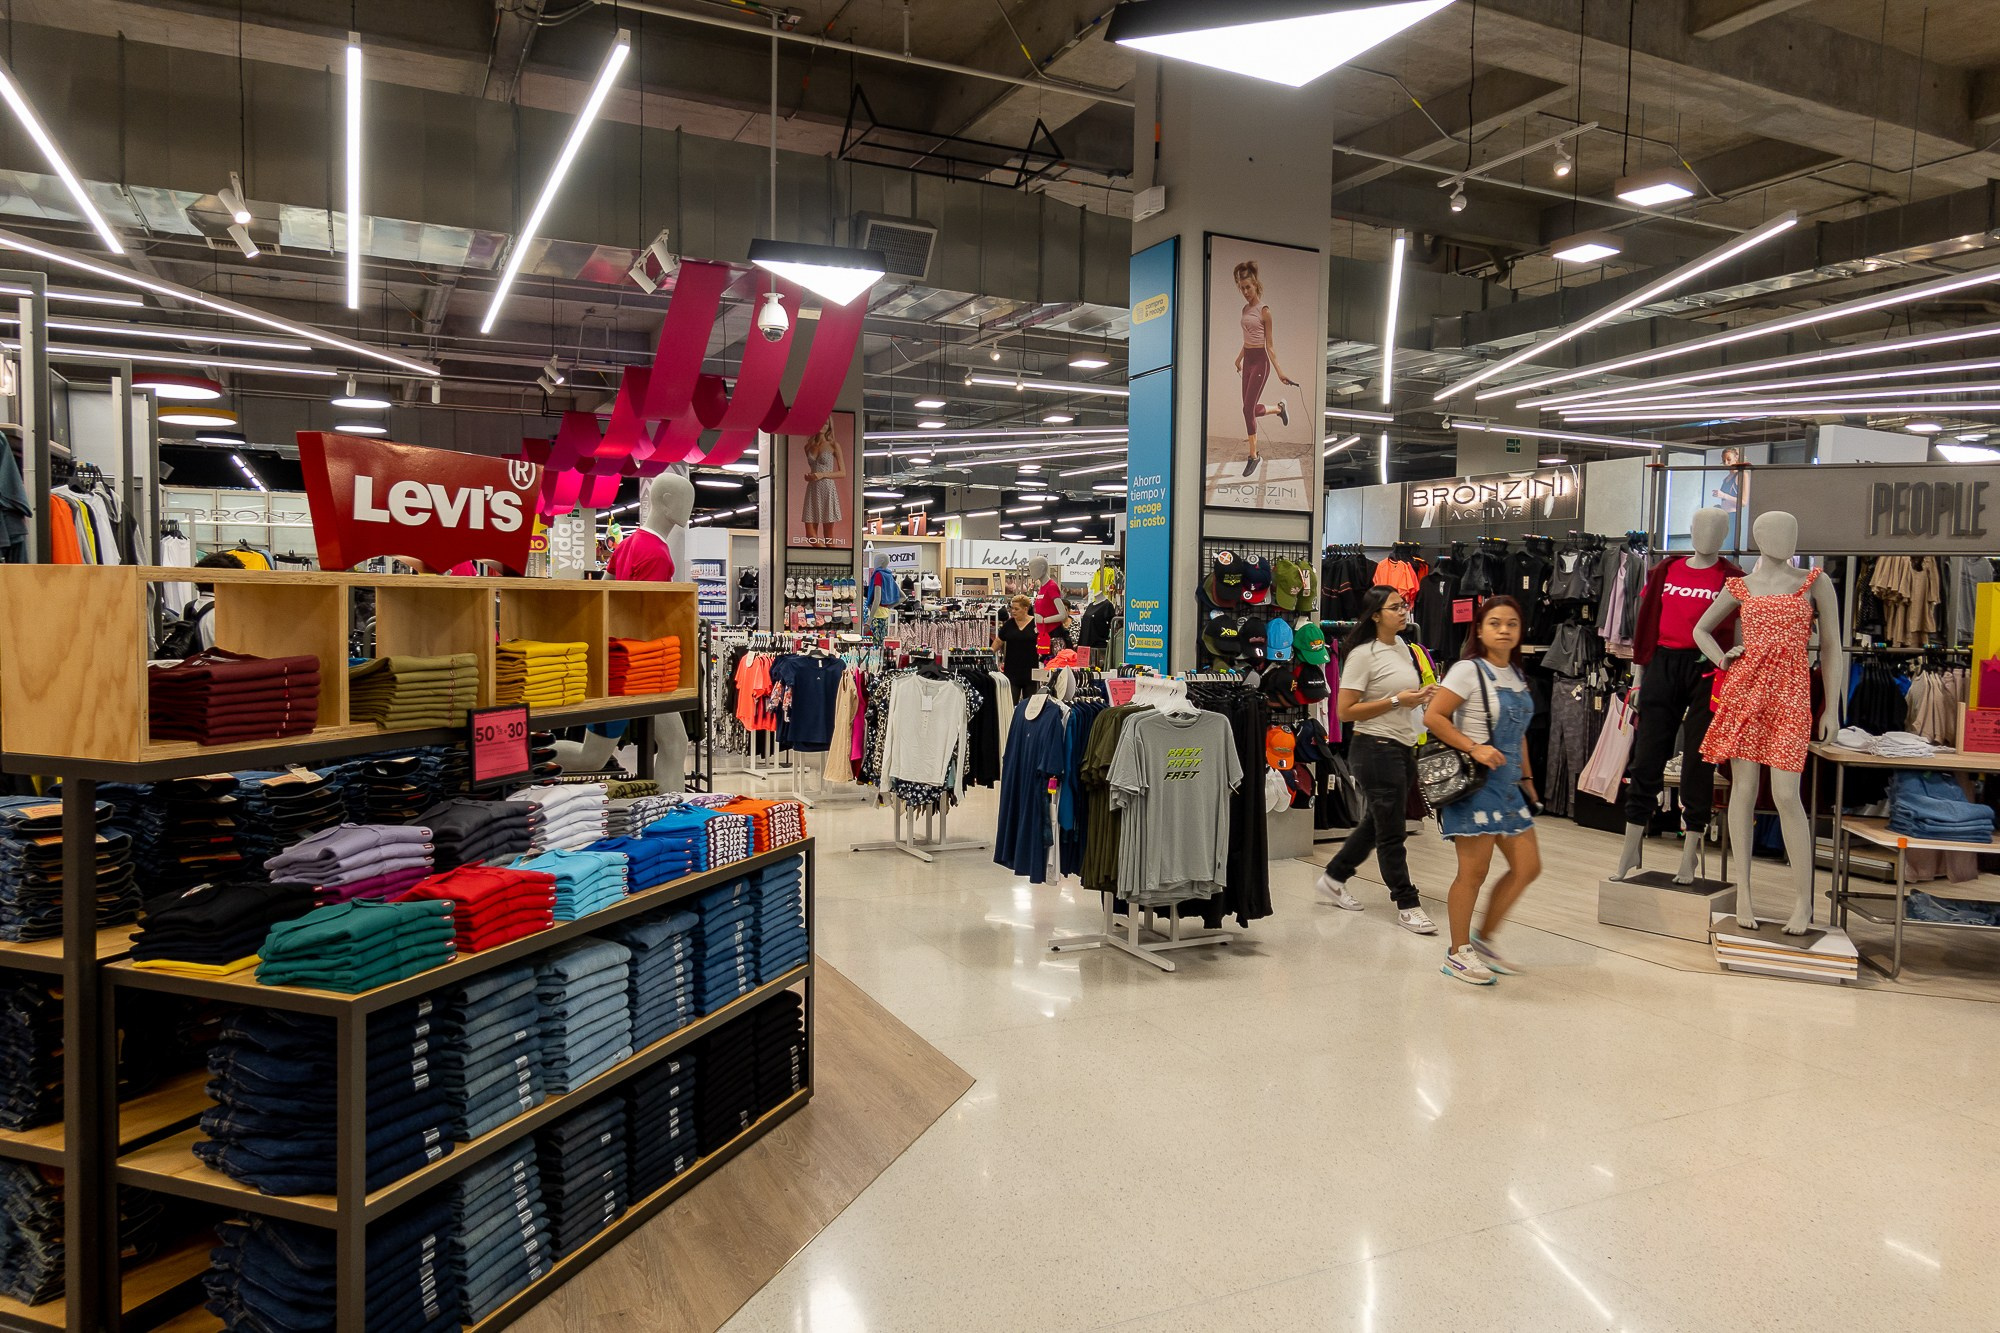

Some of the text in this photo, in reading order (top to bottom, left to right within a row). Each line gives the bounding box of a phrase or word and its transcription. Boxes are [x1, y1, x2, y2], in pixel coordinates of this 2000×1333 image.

[1133, 475, 1161, 488] Ahorra
[1130, 488, 1166, 501] tiempo y
[1217, 484, 1297, 498] BRONZINI
[1412, 476, 1562, 507] BRONZINI
[1133, 502, 1162, 514] recoge
[1450, 505, 1523, 521] ACTIVE
[1869, 481, 1989, 536] PEOPLE
[1130, 515, 1166, 528] sin costo
[553, 523, 572, 569] vida
[571, 519, 585, 569] sana
[792, 536, 846, 545] BRONZINI
[982, 548, 1030, 566] hecho
[1130, 599, 1159, 610] Compra
[1139, 611, 1151, 620] por
[1128, 622, 1163, 634] Whatsapp
[1167, 747, 1203, 757] FAST
[1167, 758, 1203, 768] FAST
[1163, 770, 1200, 780] FAST
